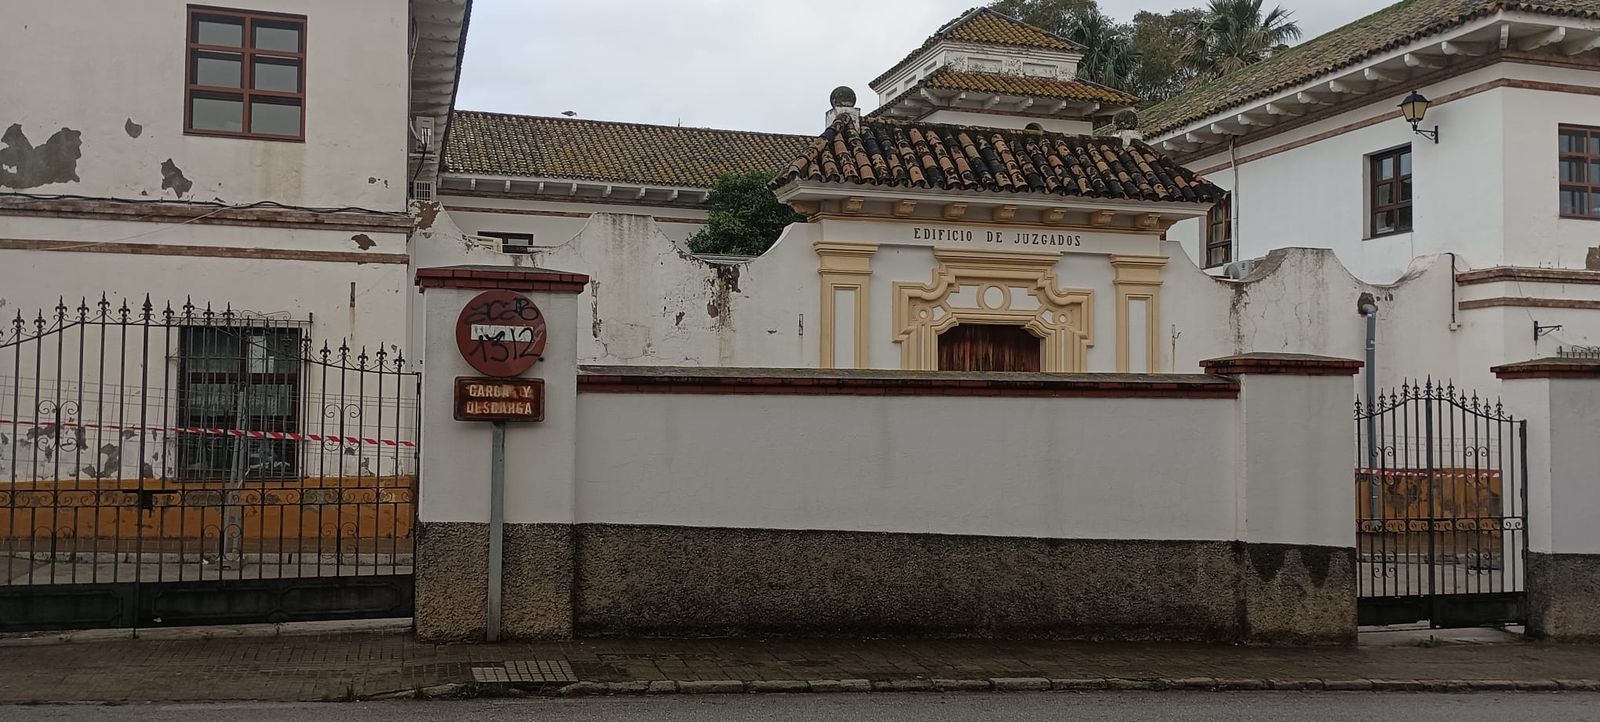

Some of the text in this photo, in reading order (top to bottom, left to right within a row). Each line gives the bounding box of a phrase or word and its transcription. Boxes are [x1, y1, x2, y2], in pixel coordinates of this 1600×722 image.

[914, 227, 1082, 247] EDIFICIO DE JUZGADOS
[522, 385, 532, 398] Y
